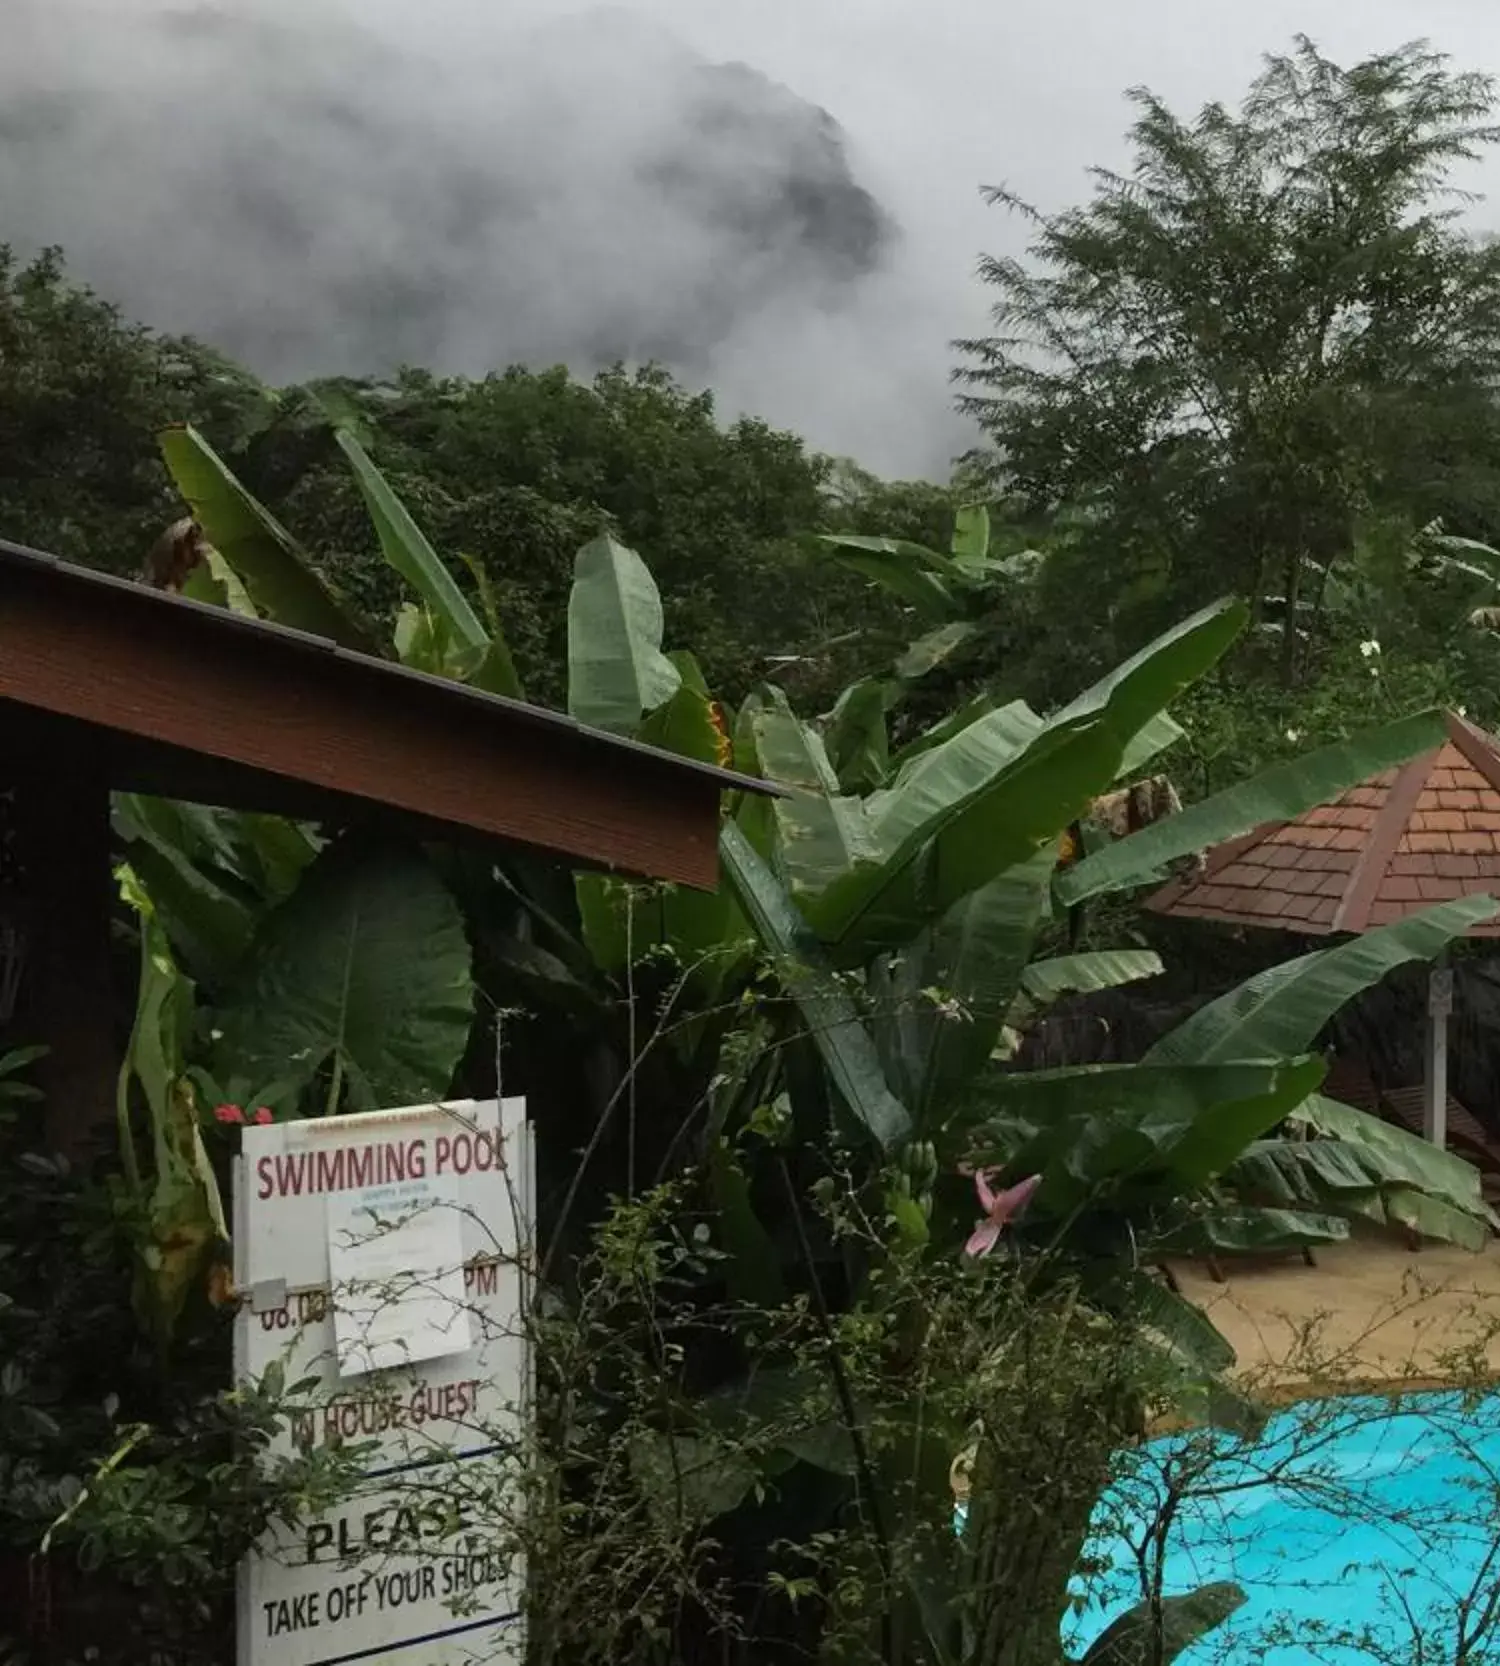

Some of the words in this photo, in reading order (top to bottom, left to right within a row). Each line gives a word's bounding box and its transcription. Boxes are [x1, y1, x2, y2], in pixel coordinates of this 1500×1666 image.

[257, 1140, 426, 1200] SWIMMING
[410, 1380, 479, 1425] GUEST
[264, 1592, 320, 1637] TAKE
[326, 1580, 369, 1622] OFF
[375, 1565, 436, 1610] YOUR
